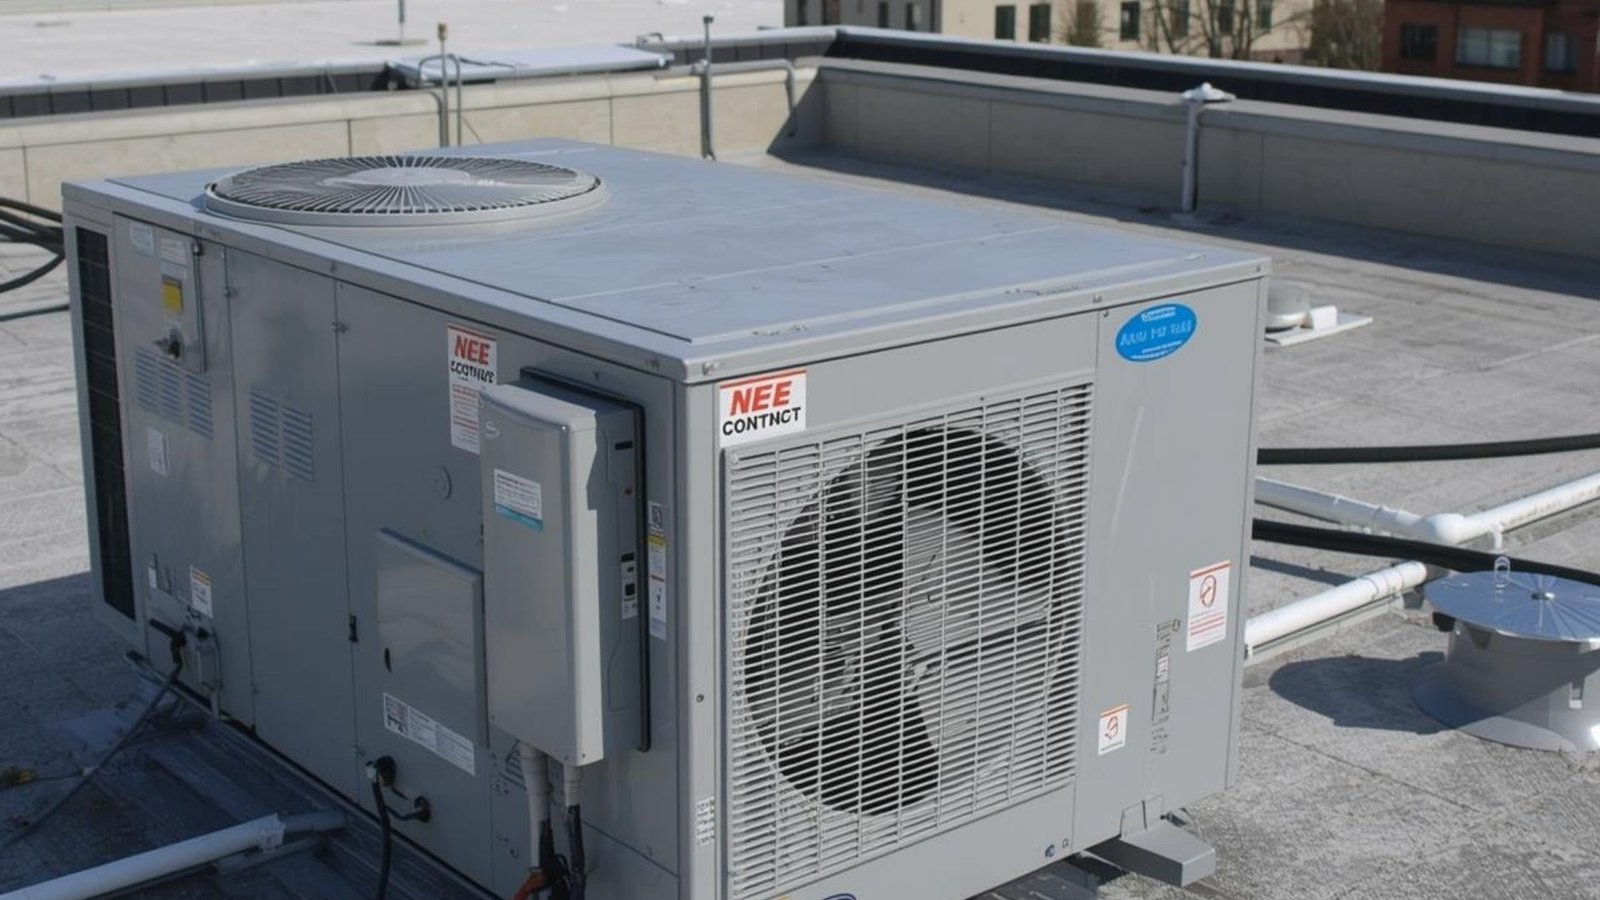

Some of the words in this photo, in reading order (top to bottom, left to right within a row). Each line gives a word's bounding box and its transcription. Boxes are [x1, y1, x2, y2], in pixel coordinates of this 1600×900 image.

[455, 335, 490, 365] NEE
[730, 381, 792, 415] NEE
[722, 407, 801, 435] CONTNCT
